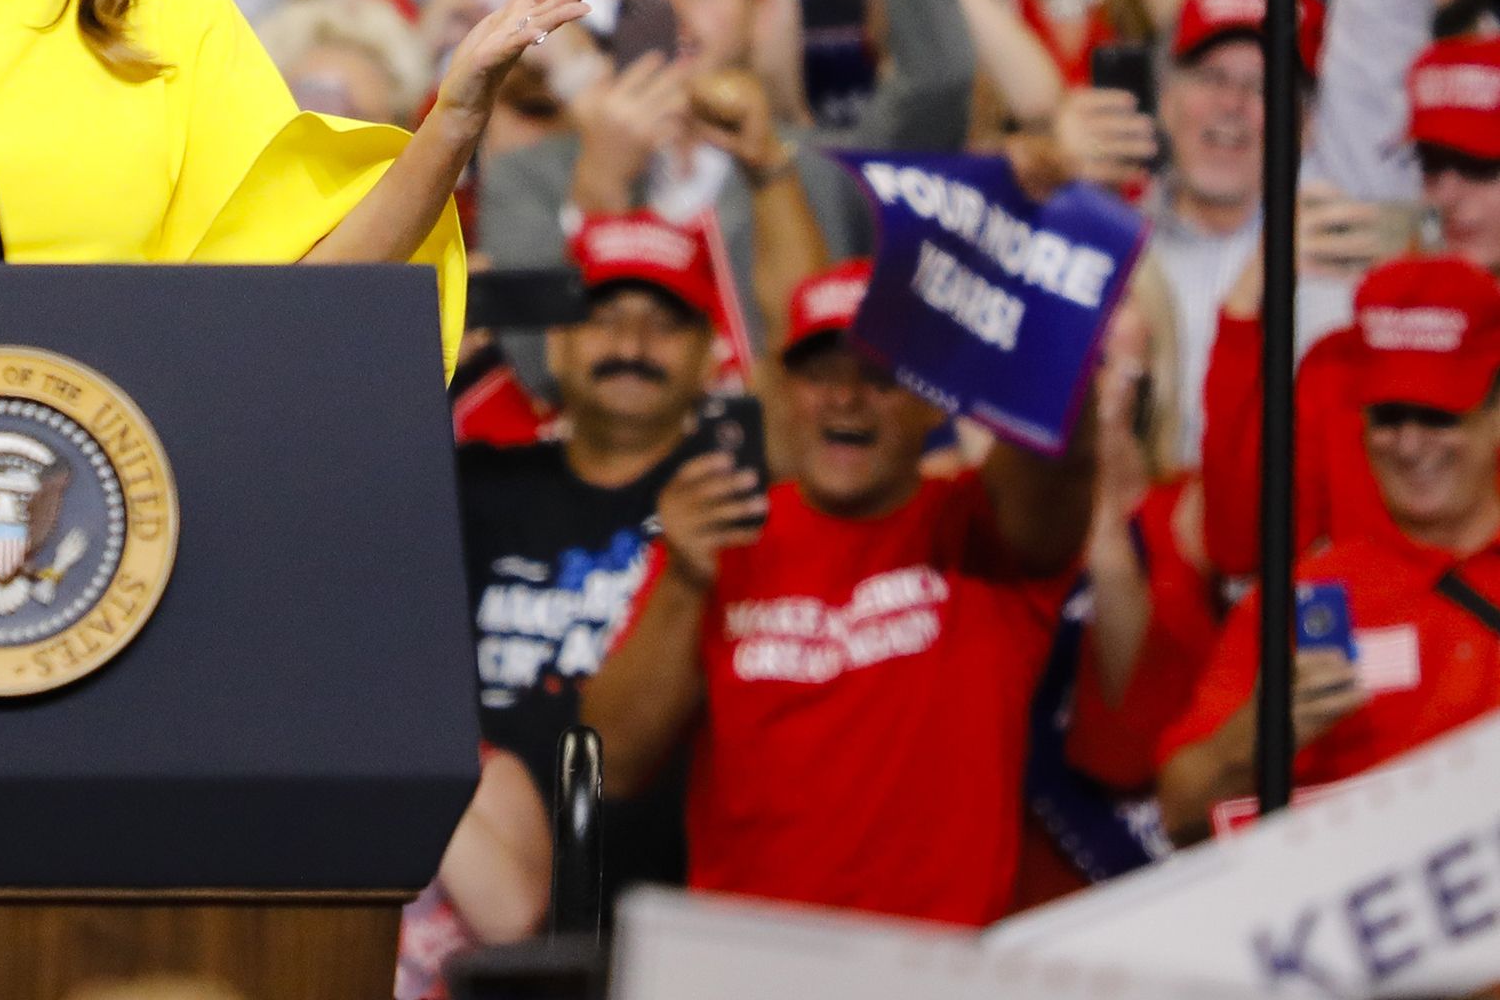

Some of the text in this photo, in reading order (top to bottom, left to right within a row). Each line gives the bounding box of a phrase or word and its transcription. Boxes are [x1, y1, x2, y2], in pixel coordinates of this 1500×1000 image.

[862, 161, 988, 243] FOUR
[91, 401, 161, 541] UNITED
[31, 572, 147, 678] STATES
[1252, 820, 1500, 998] KEE
